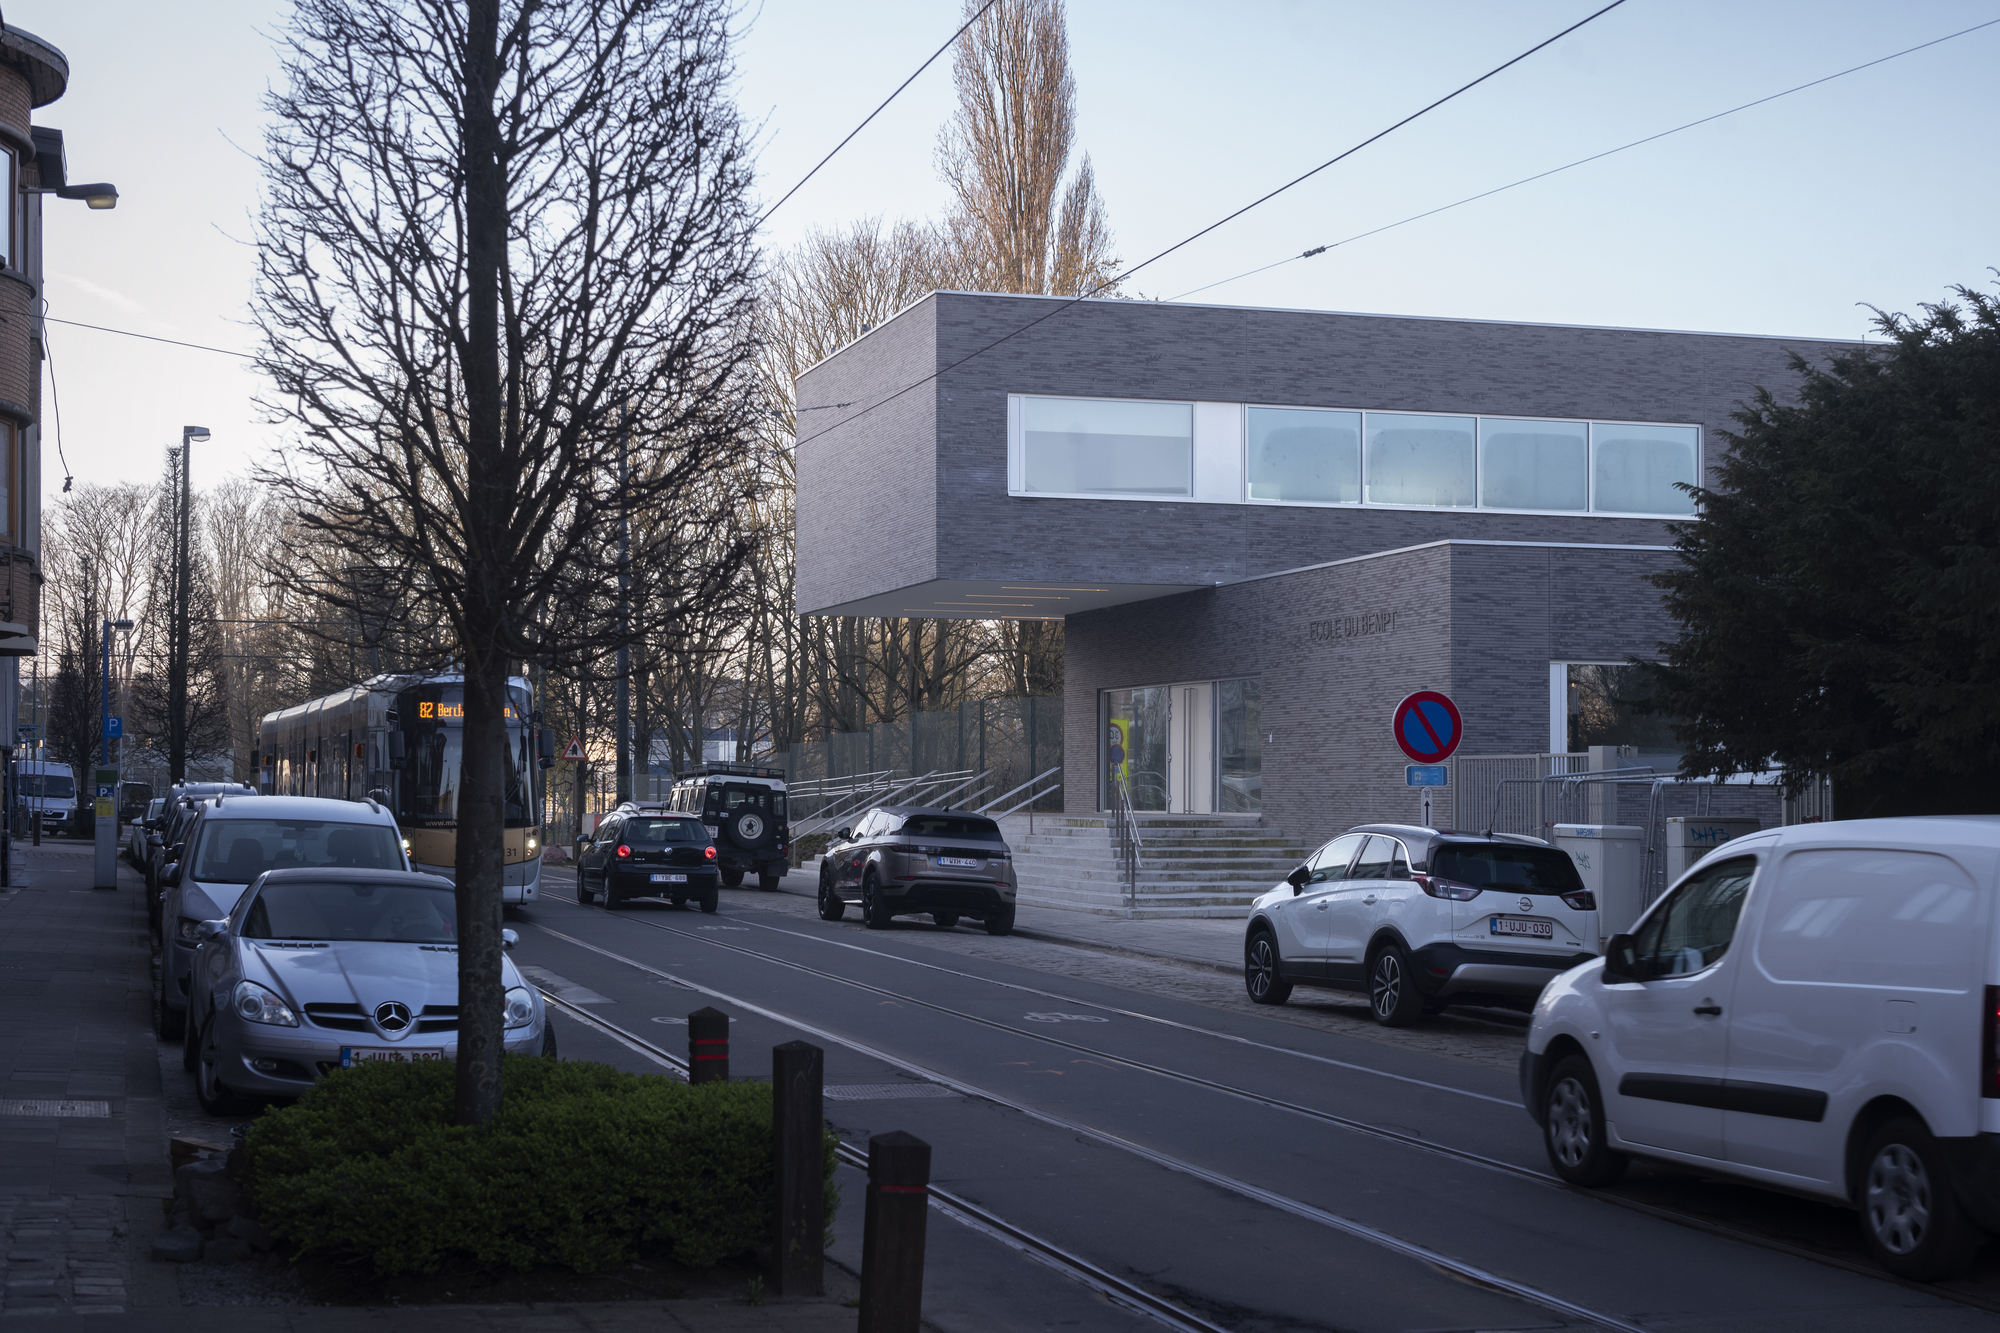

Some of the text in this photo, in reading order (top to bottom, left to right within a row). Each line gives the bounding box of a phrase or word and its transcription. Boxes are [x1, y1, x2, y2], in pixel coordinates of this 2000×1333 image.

[1310, 611, 1397, 641] ECOLE DU BEMPT
[420, 702, 464, 718] 82 Berch
[109, 718, 118, 732] P
[100, 787, 108, 797] P
[425, 819, 458, 827] www.miv
[1498, 921, 1551, 935] 1-UJU-030
